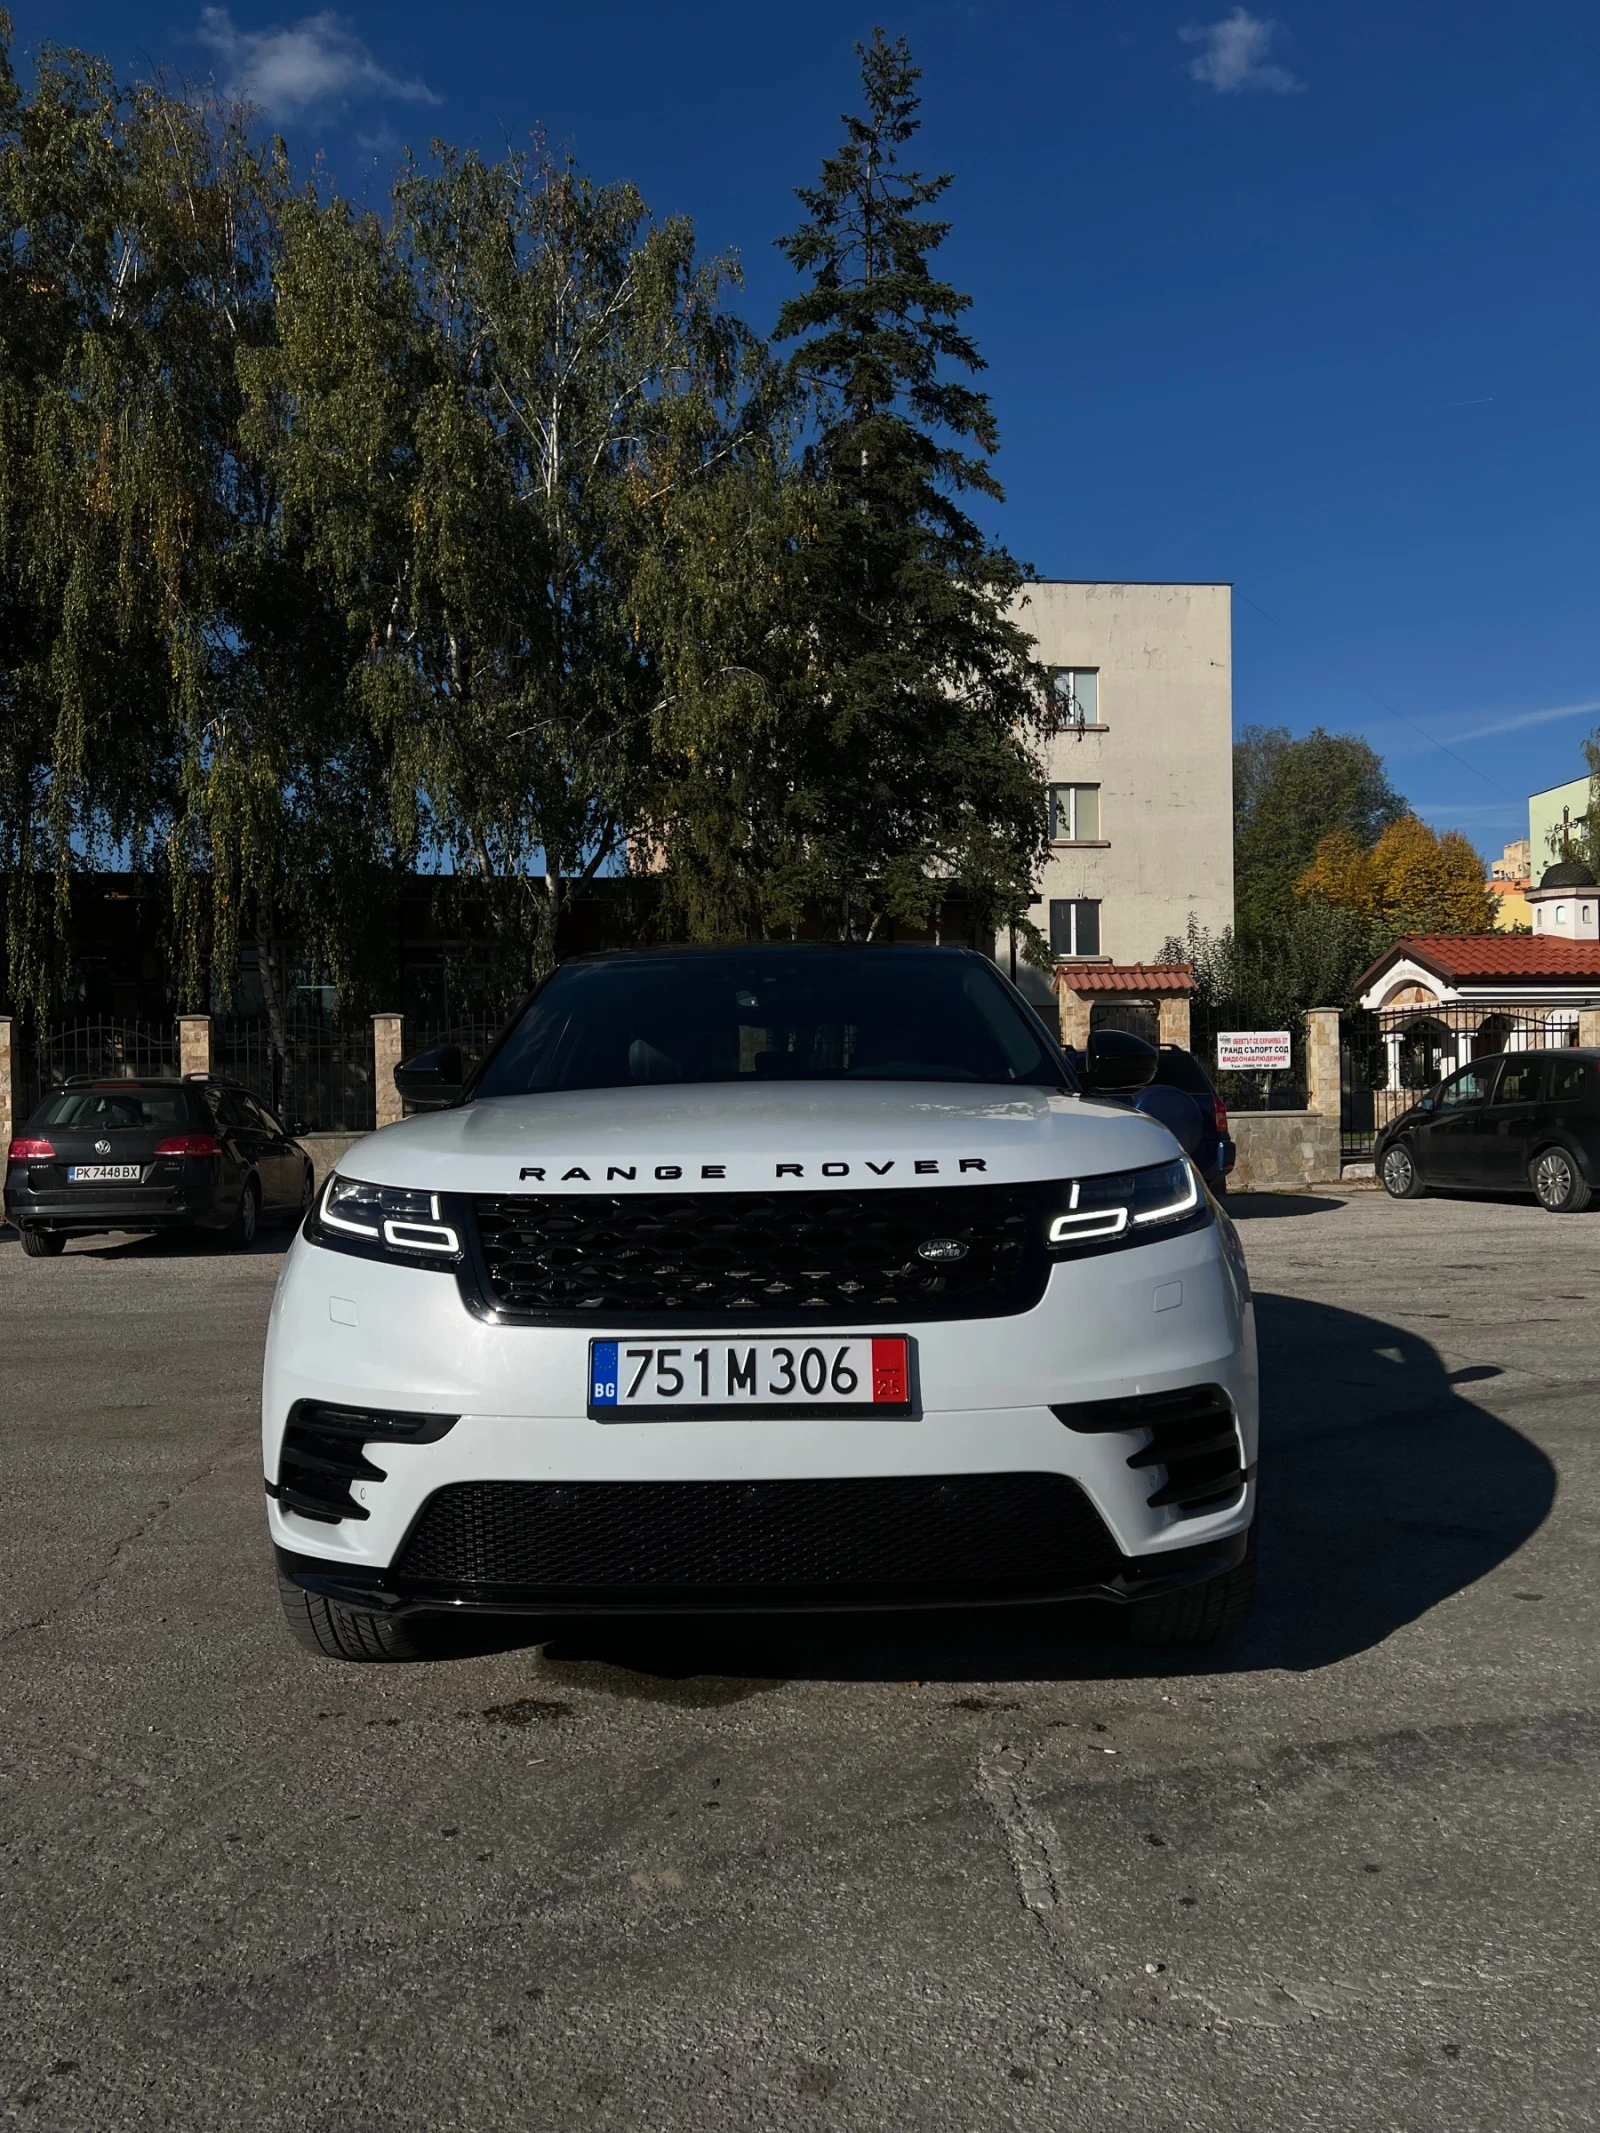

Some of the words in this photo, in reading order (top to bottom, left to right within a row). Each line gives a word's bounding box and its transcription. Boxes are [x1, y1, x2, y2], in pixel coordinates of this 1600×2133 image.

[1220, 1046, 1243, 1054] ГРАНД
[1274, 1046, 1289, 1054] СОД
[1222, 1055, 1286, 1063] ВИДЕОНАБЛЮДЕНИЕ
[93, 1167, 120, 1178] 7448
[519, 1165, 727, 1182] RANGE
[775, 1158, 988, 1179] ROVER
[594, 1382, 615, 1398] BG
